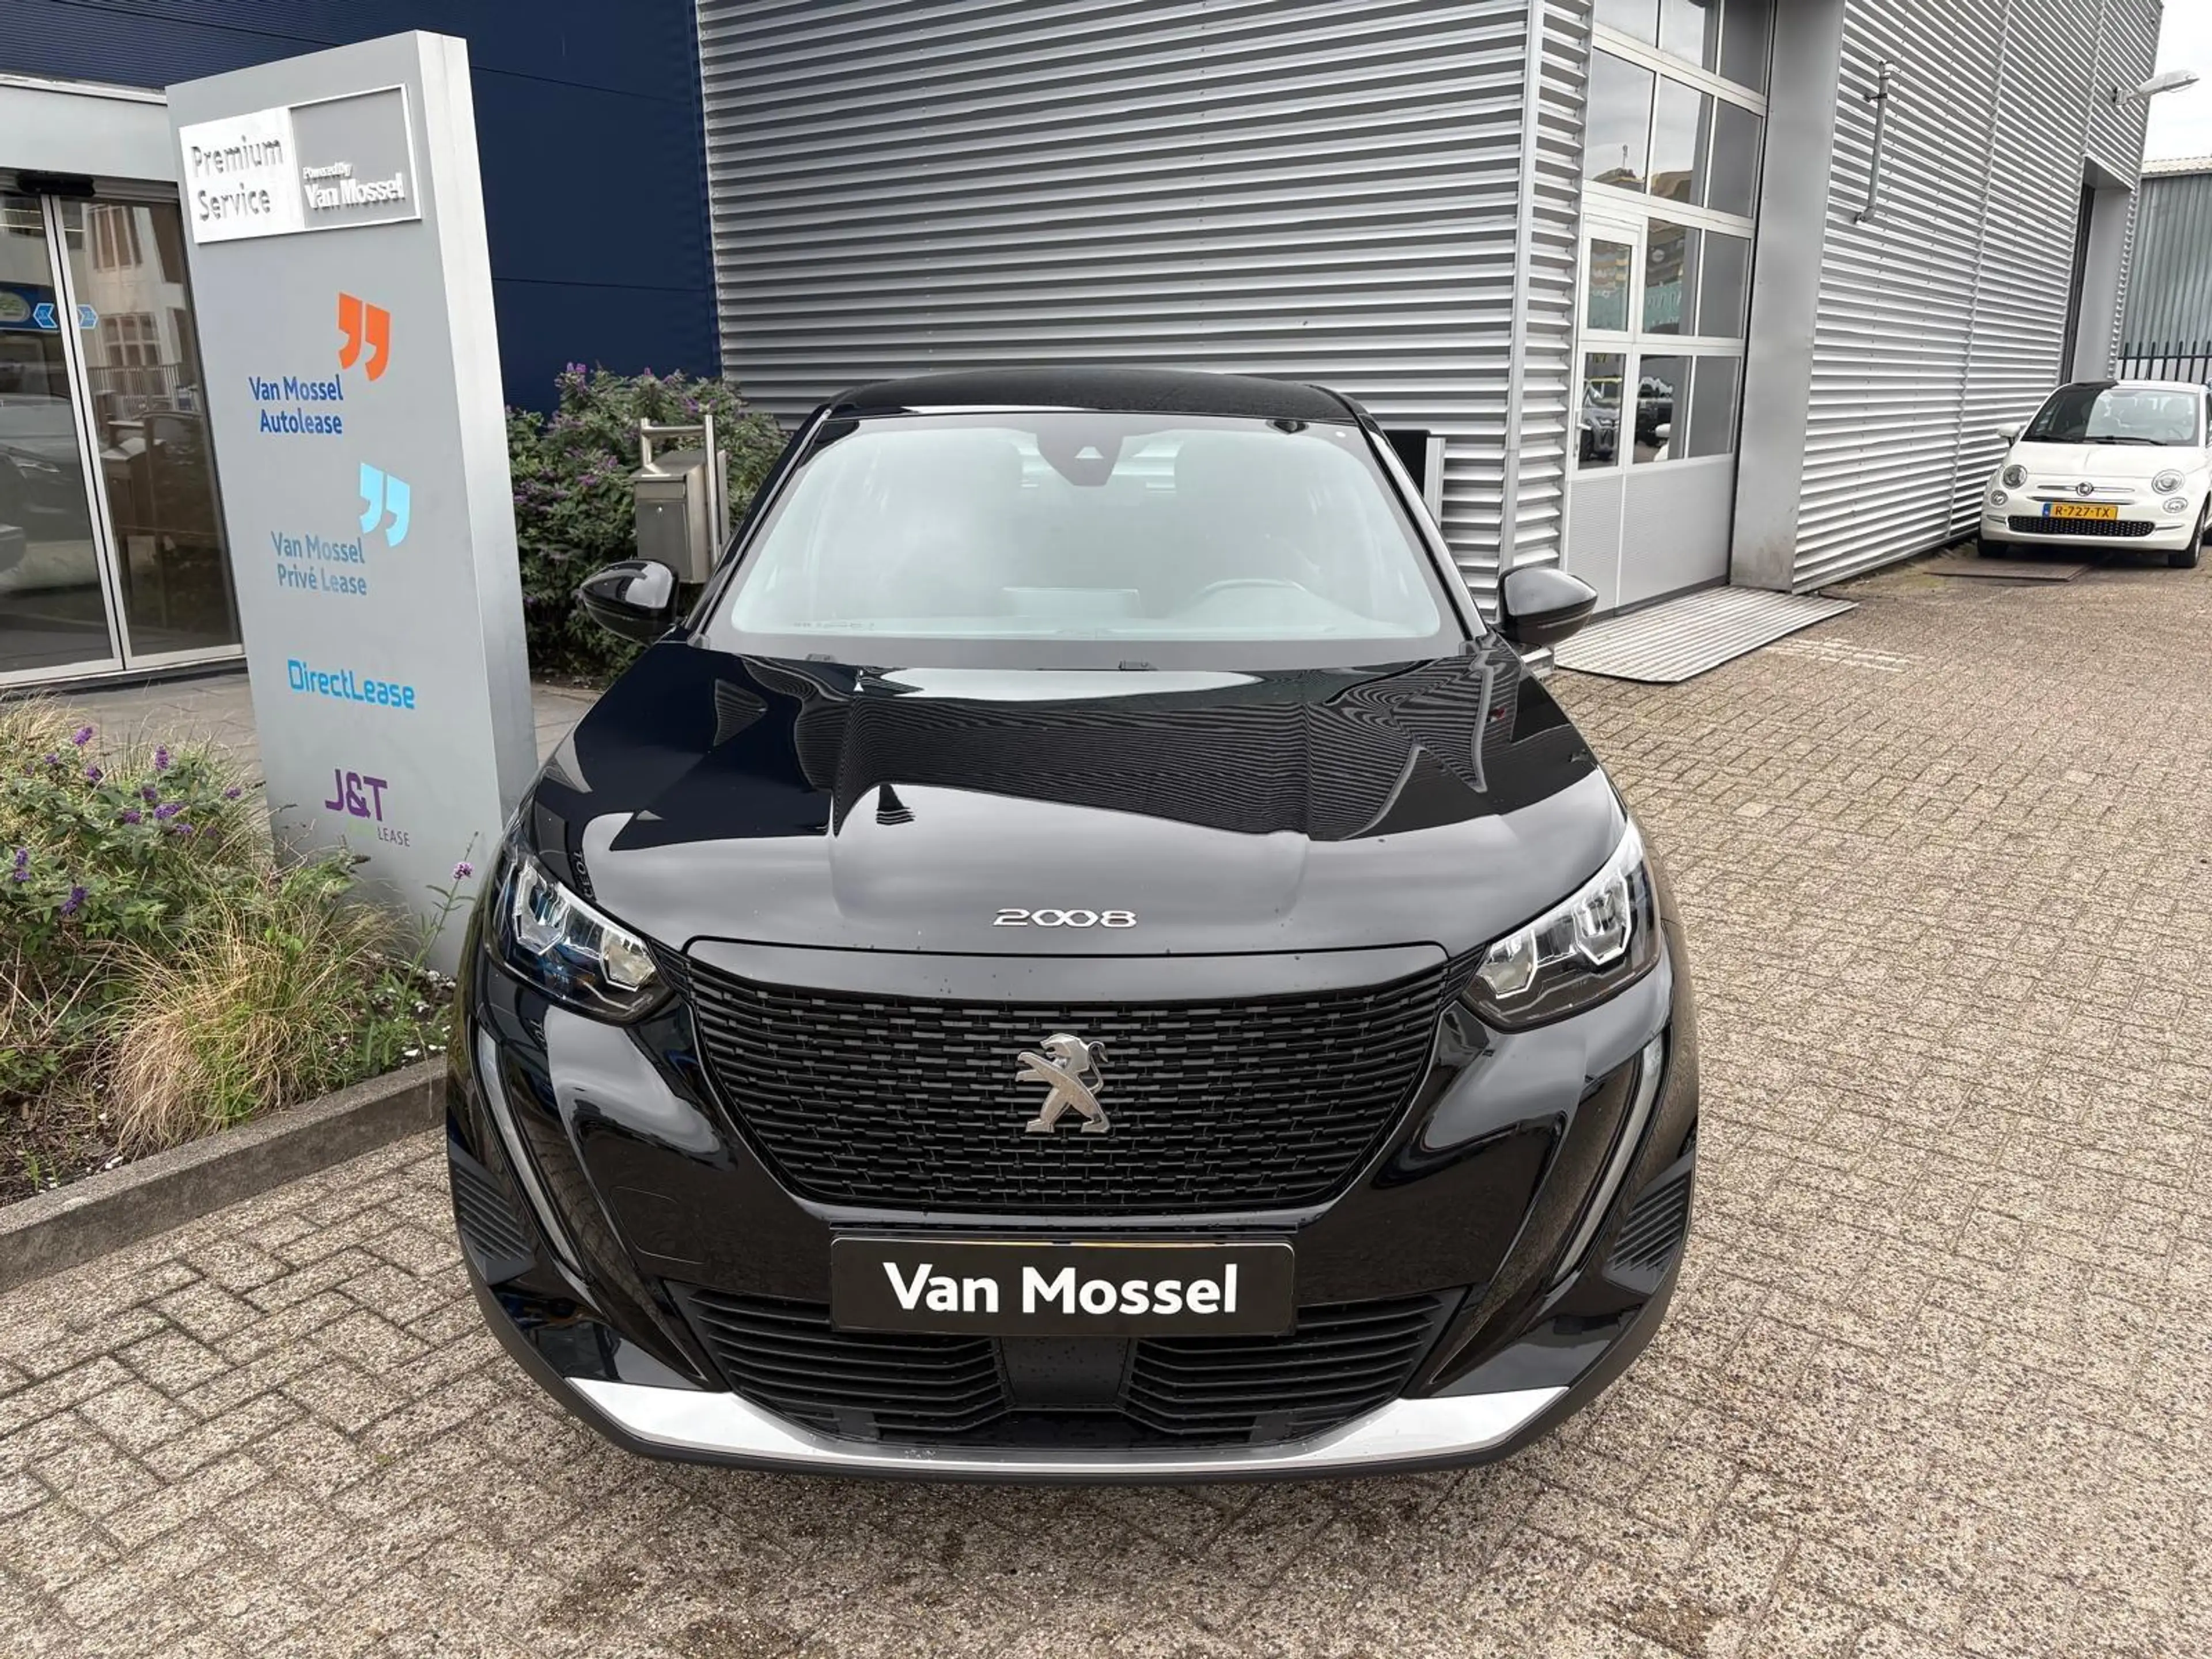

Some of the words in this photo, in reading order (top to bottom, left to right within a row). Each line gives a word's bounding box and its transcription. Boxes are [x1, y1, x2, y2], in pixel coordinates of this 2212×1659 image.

[191, 135, 283, 177] Premium
[198, 182, 271, 222] Service
[304, 183, 340, 209] Van
[340, 173, 405, 205] Mossel
[248, 376, 281, 401] Van
[283, 373, 344, 401] Mossel
[260, 407, 343, 434] Autolease
[2055, 505, 2110, 518] R-727-TX
[270, 531, 303, 558] Van
[305, 533, 366, 564] Mossel
[277, 563, 318, 590] Privé
[320, 567, 368, 596] Lease
[287, 658, 415, 710] DirectLease
[325, 768, 388, 822] J&T
[377, 825, 411, 847] LEASE
[992, 908, 1138, 929] 2008
[882, 1262, 999, 1313] Van
[1022, 1263, 1238, 1315] Mossel
